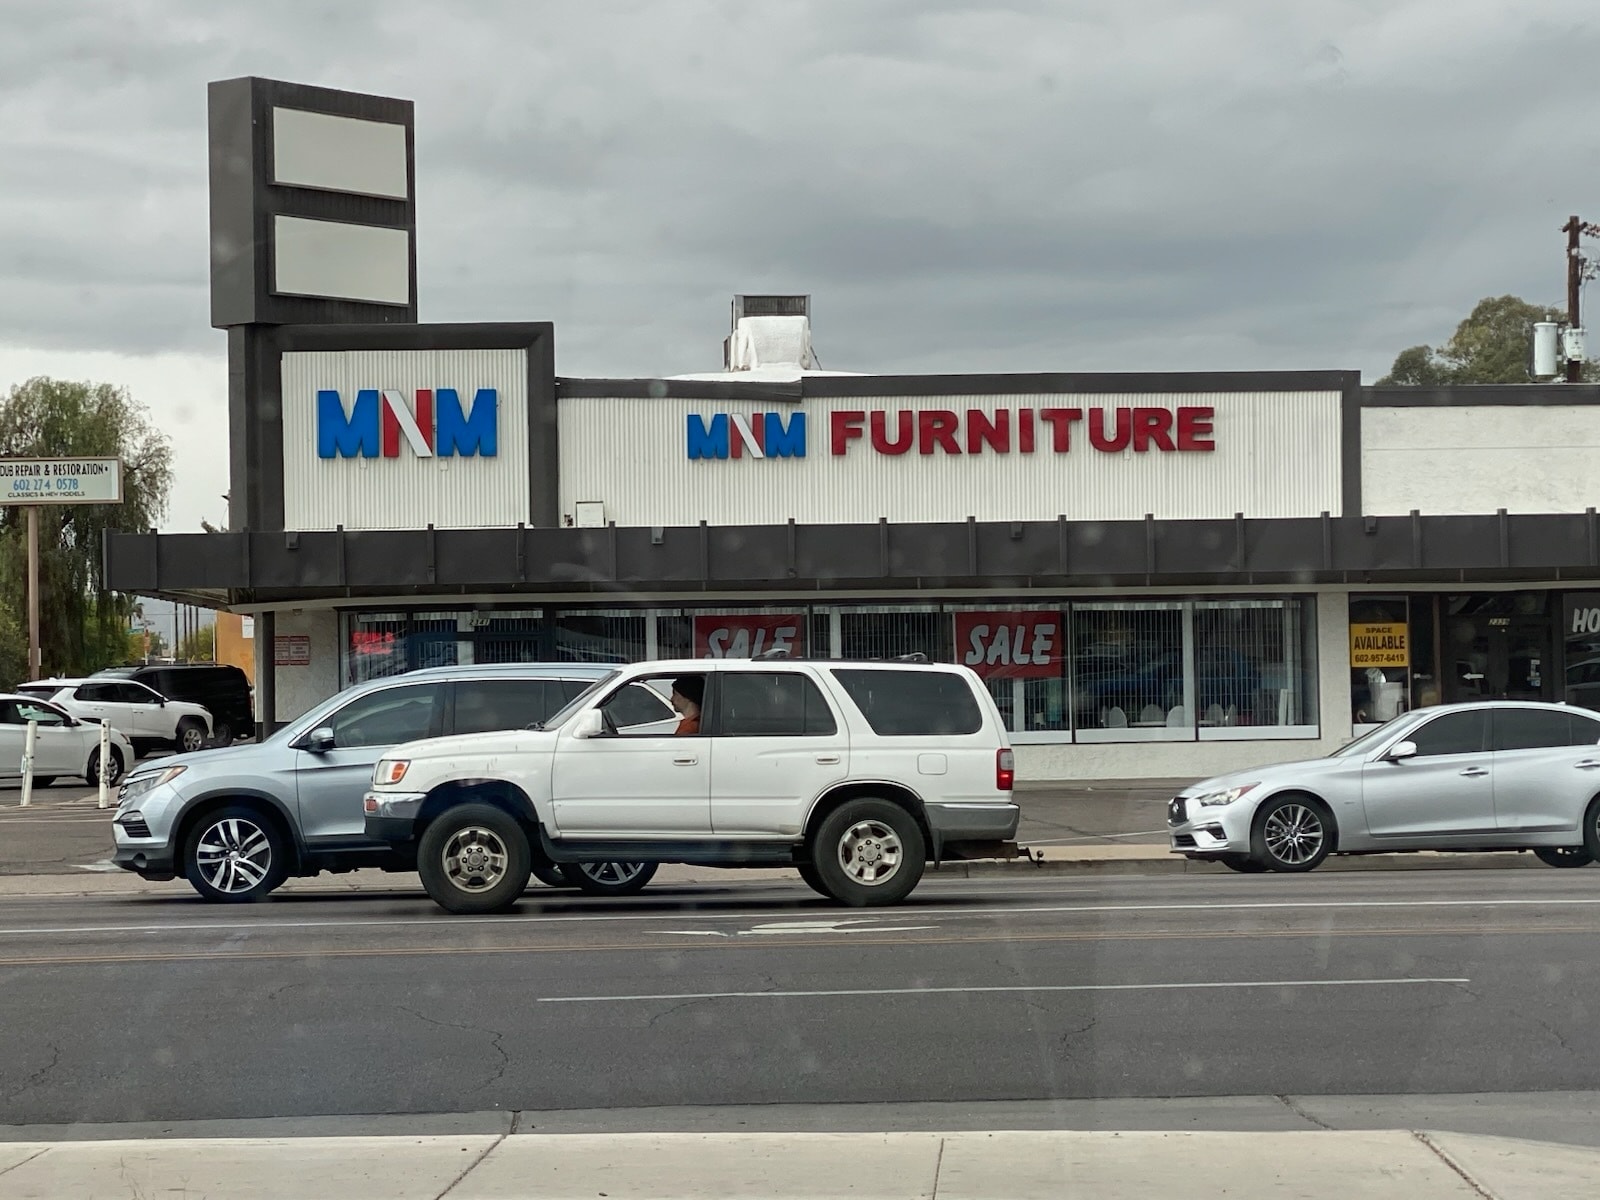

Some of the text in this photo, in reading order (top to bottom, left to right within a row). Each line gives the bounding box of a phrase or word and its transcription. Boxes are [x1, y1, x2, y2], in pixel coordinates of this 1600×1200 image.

[318, 389, 497, 458] MNM
[687, 406, 1215, 459] MNM FURNITURE
[15, 464, 41, 476] REPAIR
[44, 464, 50, 475] &
[53, 463, 104, 475] RESTORATION
[13, 478, 79, 491] 602 274 0578
[965, 623, 1056, 666] SALE
[1354, 635, 1405, 650] AVAILABLE
